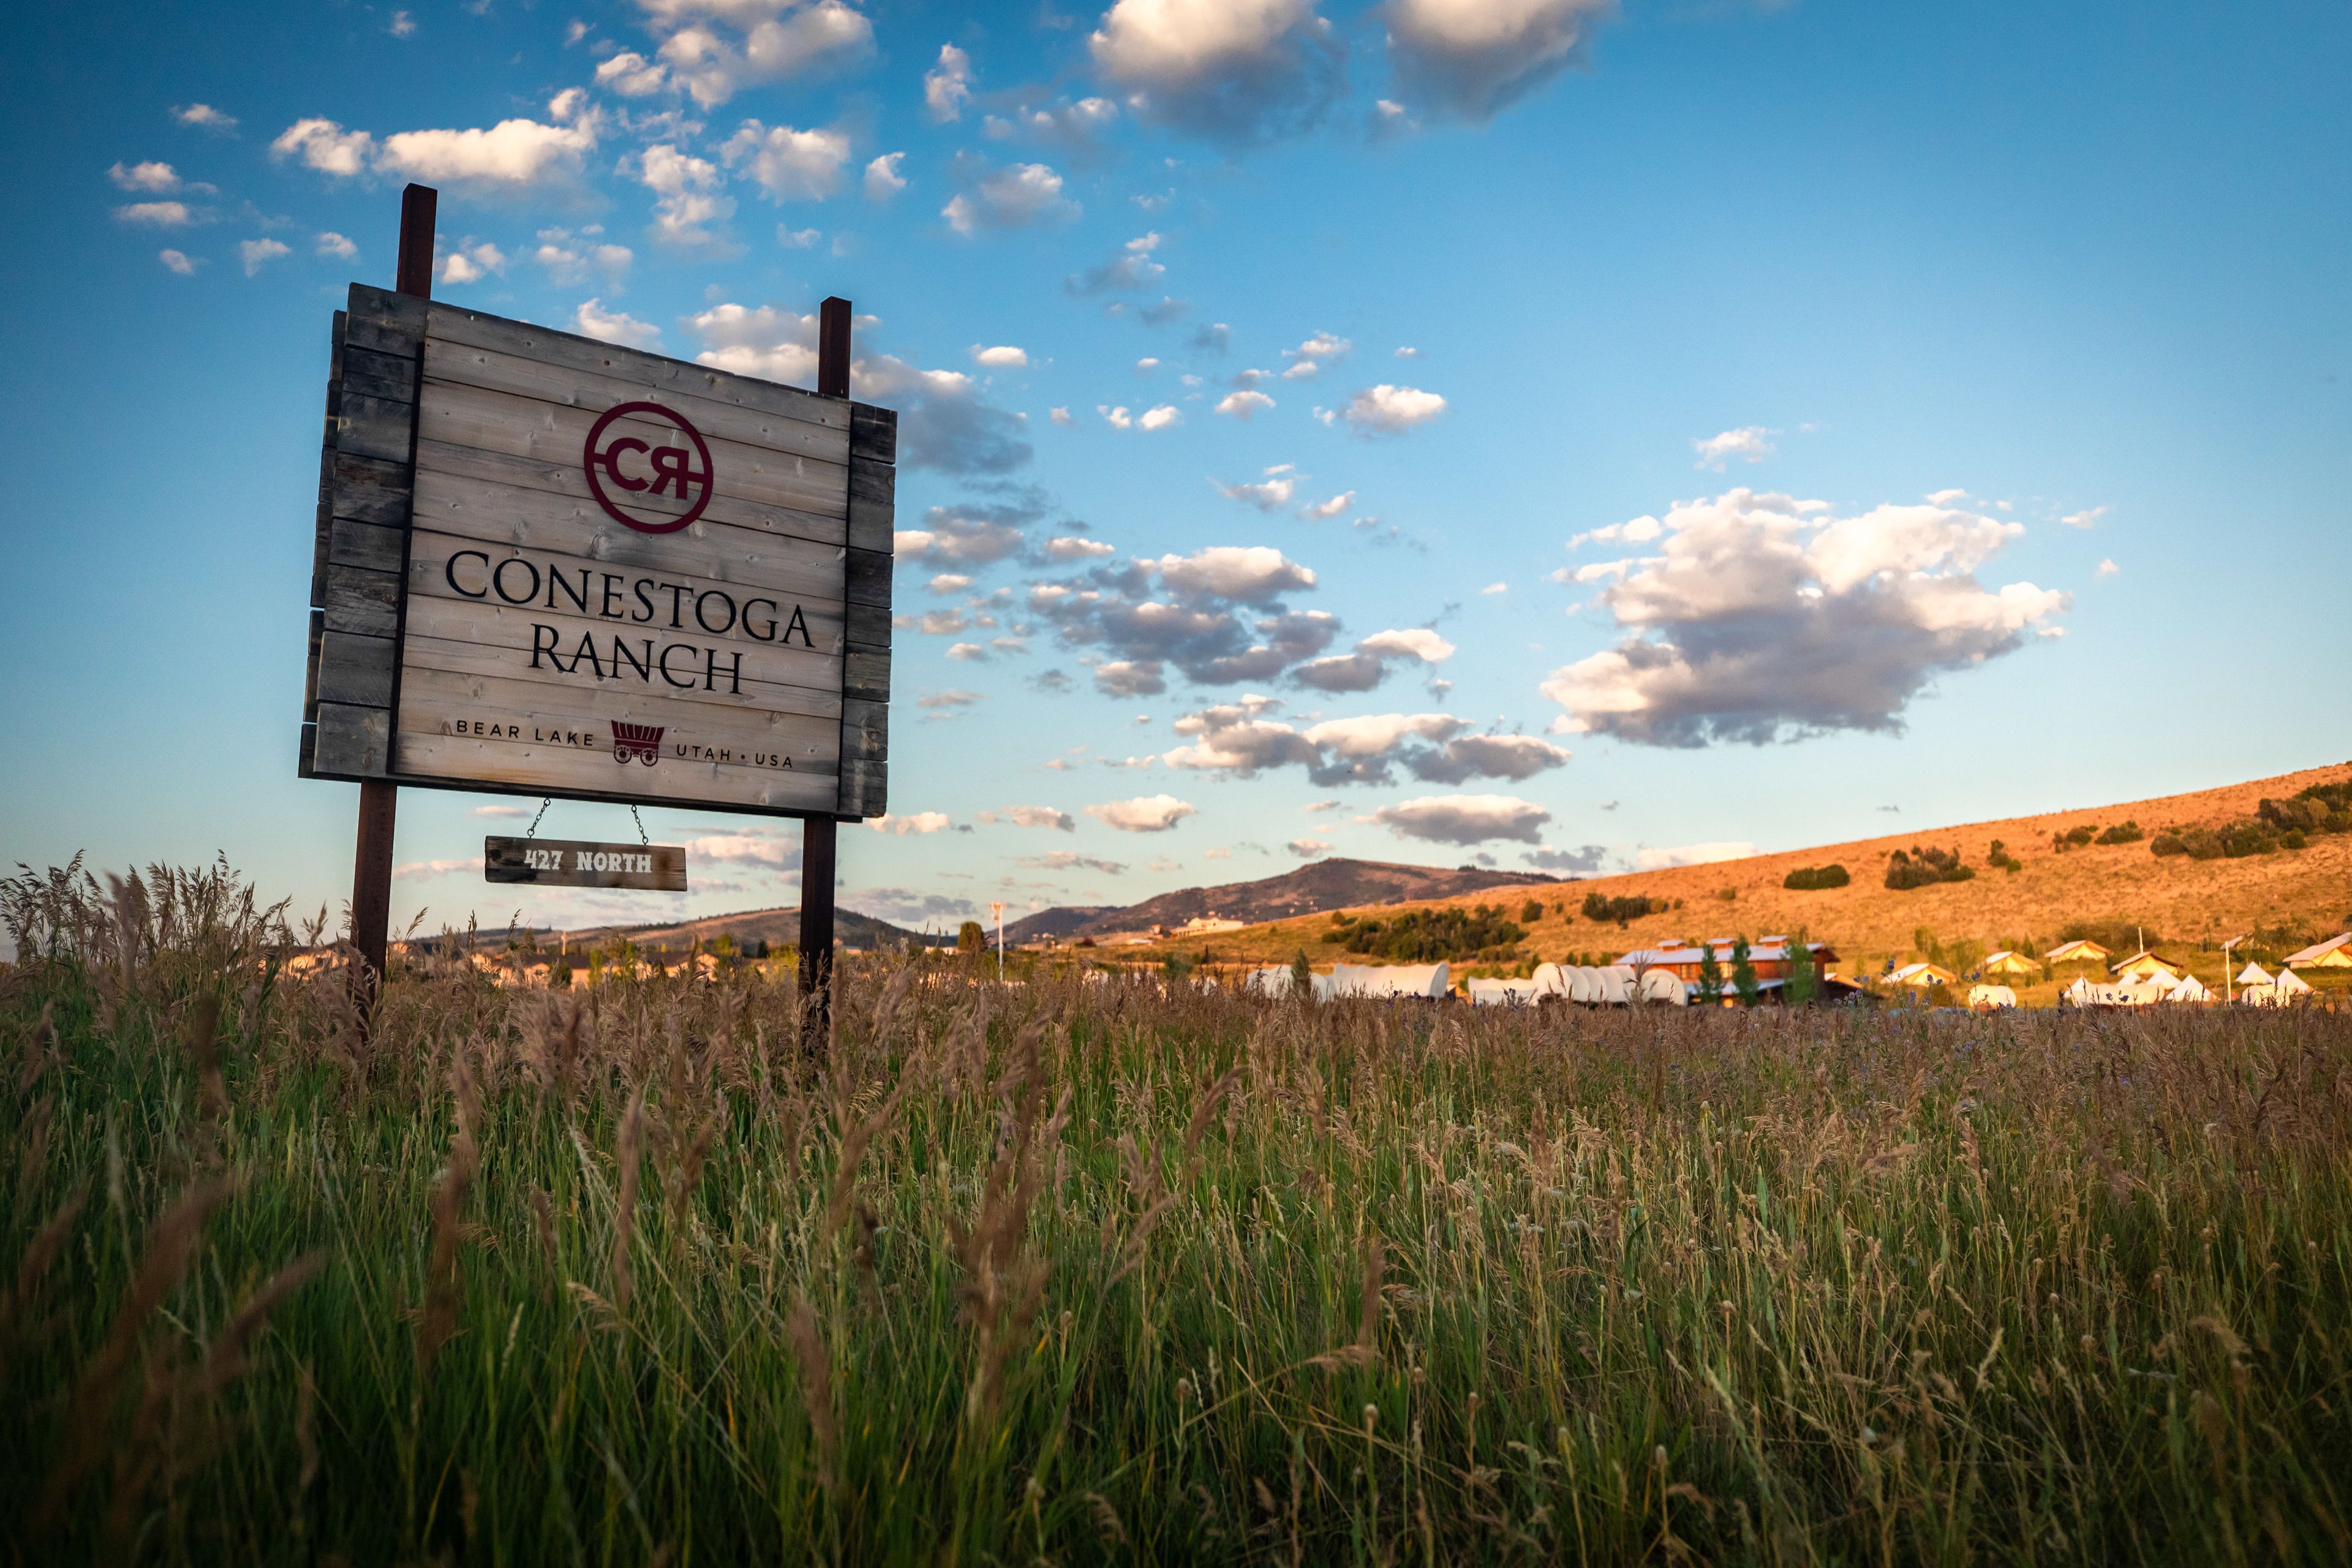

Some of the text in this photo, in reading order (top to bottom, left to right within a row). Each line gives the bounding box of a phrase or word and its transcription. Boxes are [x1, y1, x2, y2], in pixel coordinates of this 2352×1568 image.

[445, 550, 816, 648] CONESTOGA
[528, 623, 744, 695] RANCH
[456, 720, 793, 769] BEAR LAKE UTAH USA
[524, 849, 652, 873] 427 NORTH
